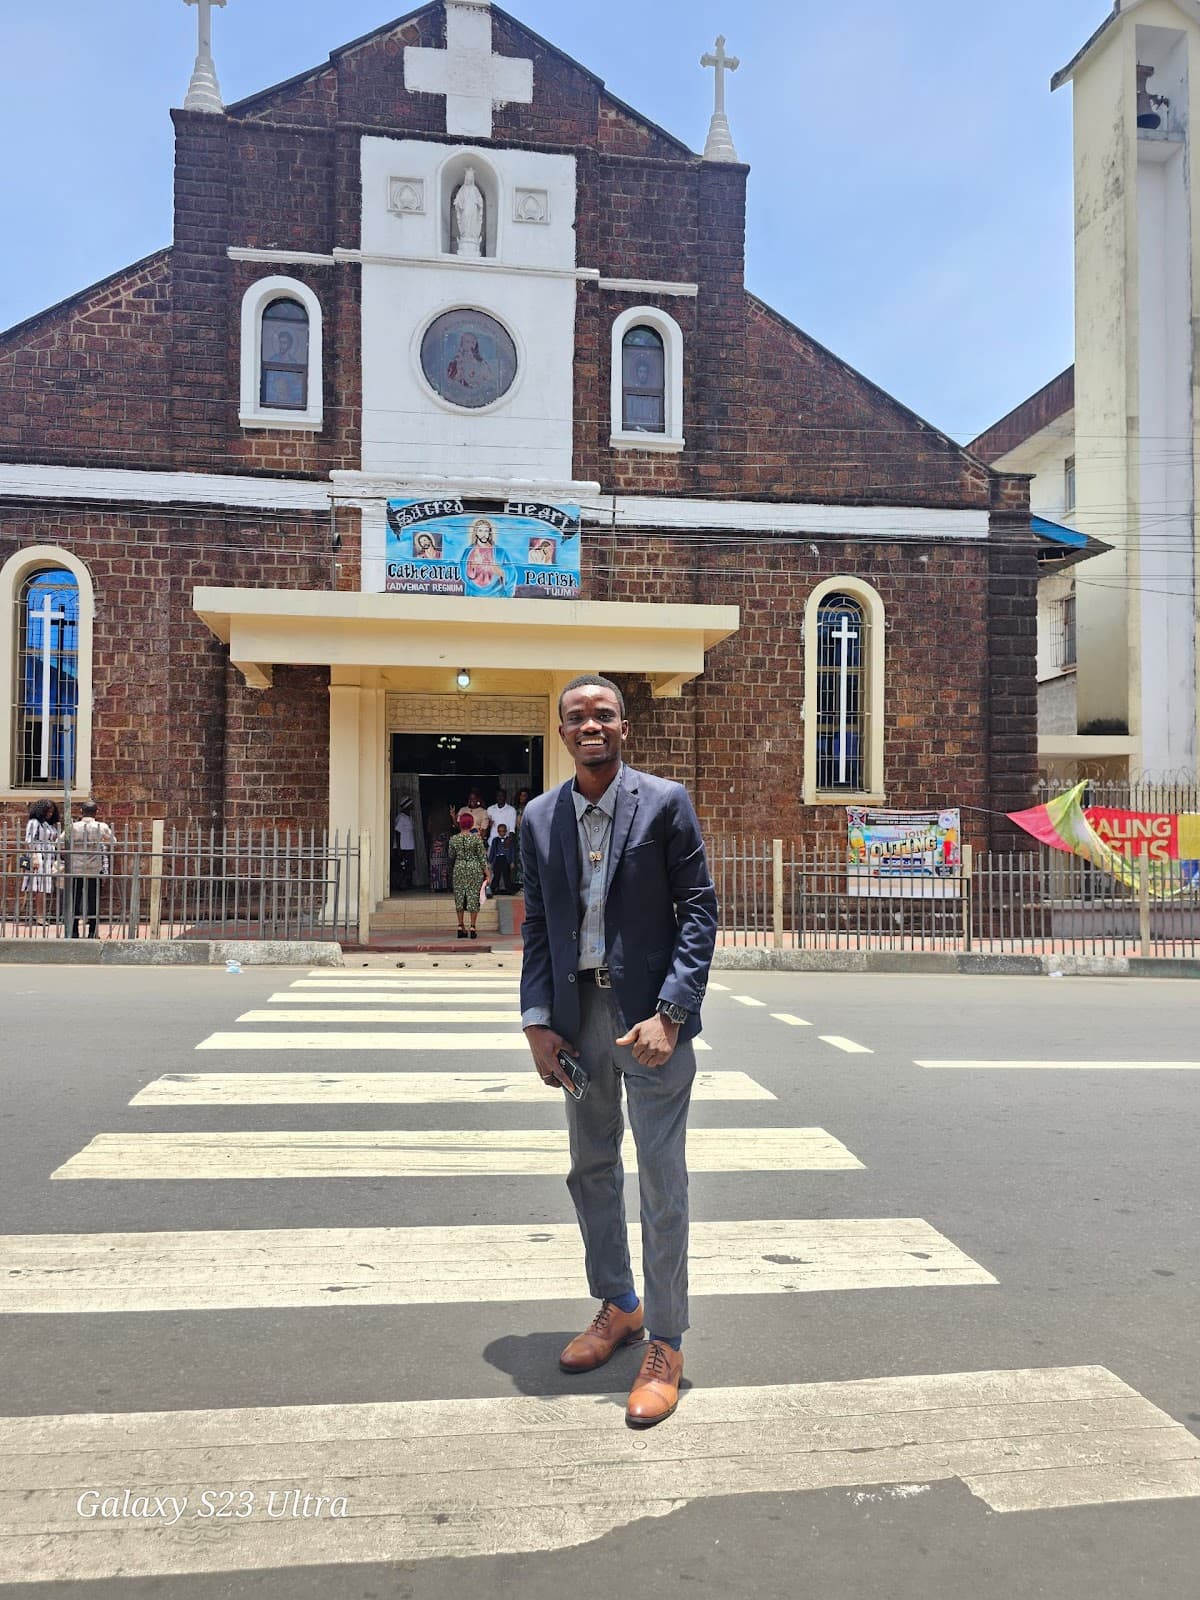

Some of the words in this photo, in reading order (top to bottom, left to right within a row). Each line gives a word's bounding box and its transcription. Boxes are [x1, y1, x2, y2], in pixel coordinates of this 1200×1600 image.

[396, 499, 464, 527] Sacred
[504, 503, 570, 529] Heart
[388, 563, 461, 581] Cathedral
[526, 571, 578, 587] Parish
[433, 584, 463, 593] REGNUM
[870, 836, 938, 857] OUTING
